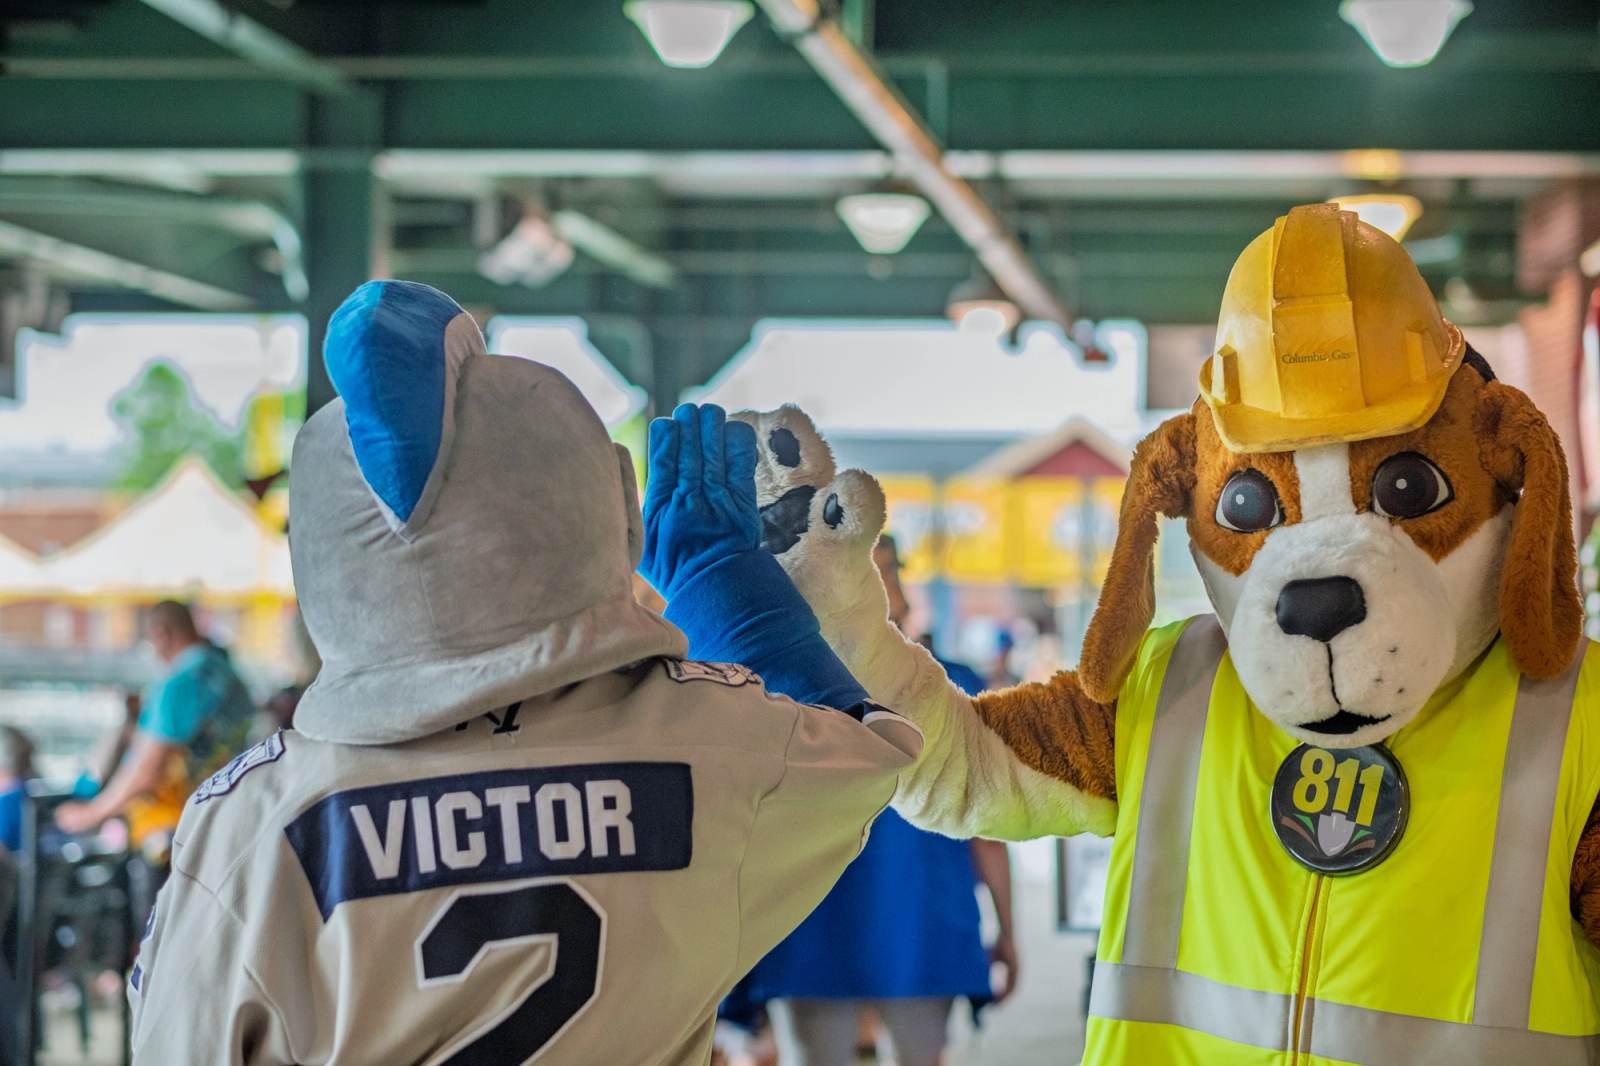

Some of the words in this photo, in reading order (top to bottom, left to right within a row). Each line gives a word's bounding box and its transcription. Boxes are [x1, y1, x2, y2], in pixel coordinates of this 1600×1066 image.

[349, 779, 637, 880] VICTOR
[1292, 748, 1385, 827] 811
[414, 876, 608, 1066] 2
